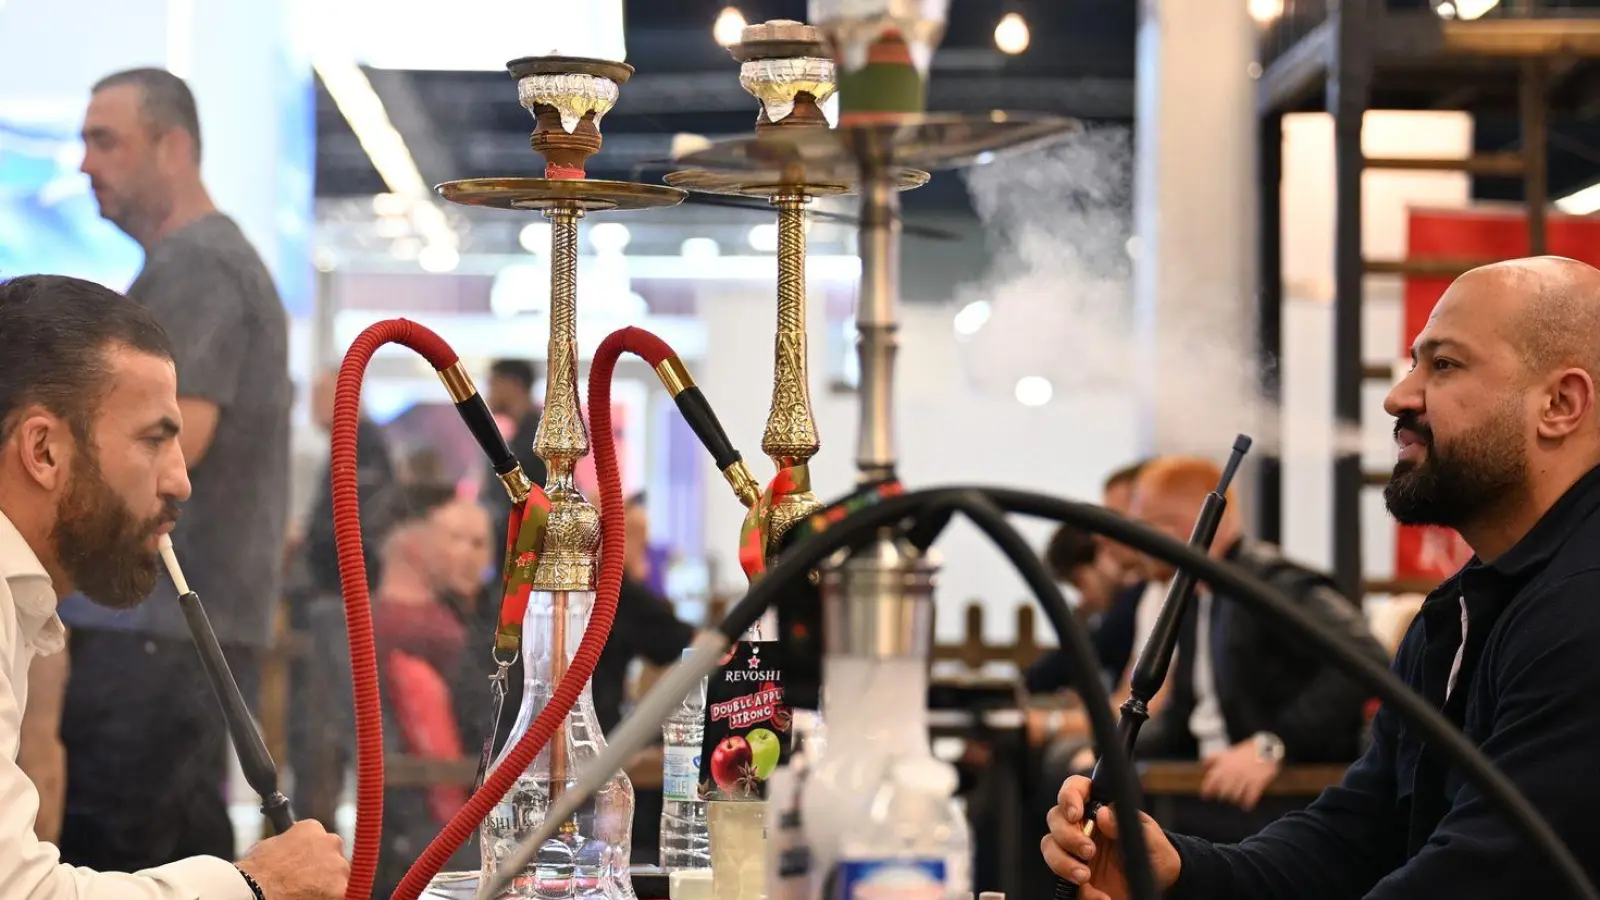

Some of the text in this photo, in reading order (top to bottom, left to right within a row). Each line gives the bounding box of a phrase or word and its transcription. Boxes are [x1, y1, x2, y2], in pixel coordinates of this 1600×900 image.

[725, 670, 781, 682] REVOSHI
[713, 689, 784, 717] DOUBLE APPL
[732, 705, 771, 725] STRONG
